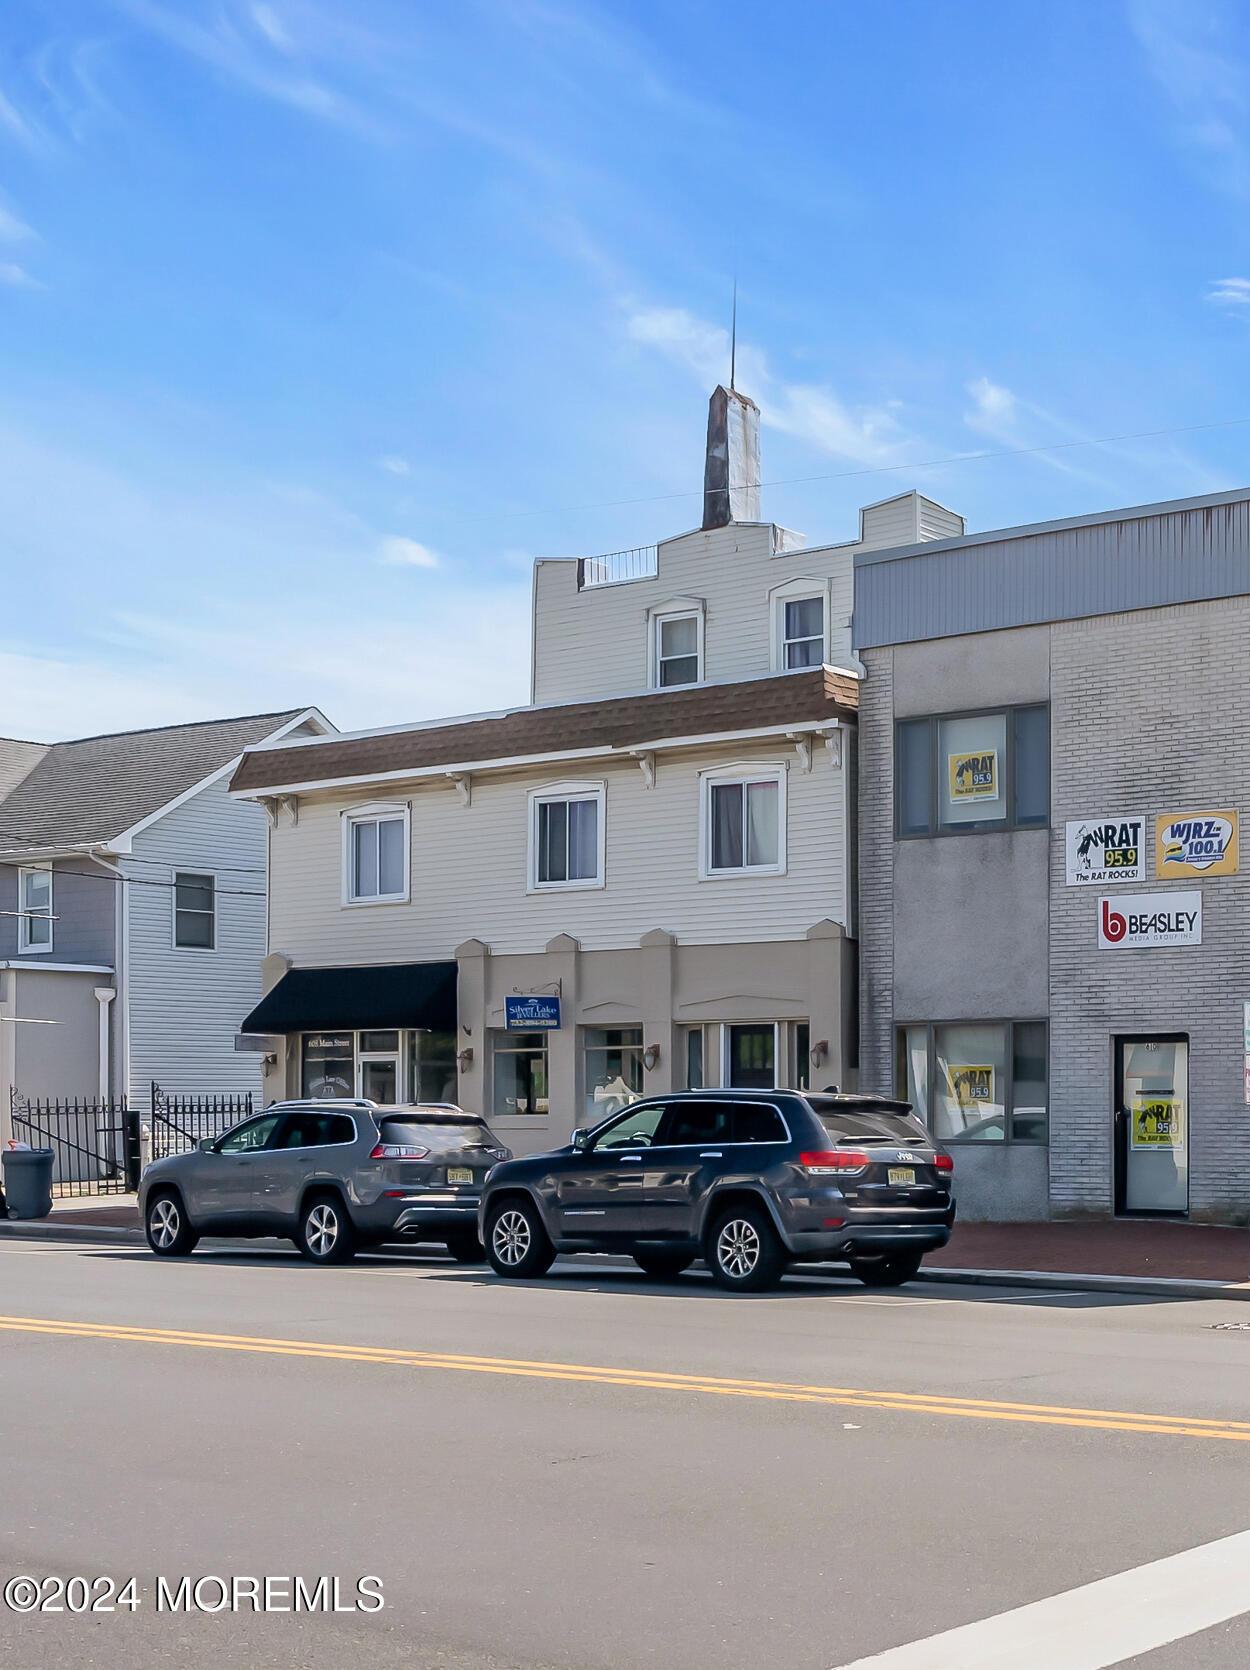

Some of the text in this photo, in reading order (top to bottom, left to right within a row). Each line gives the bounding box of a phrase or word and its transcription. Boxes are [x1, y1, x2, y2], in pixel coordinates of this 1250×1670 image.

[973, 773, 992, 785] 95.9
[1170, 821, 1220, 844] WJRZ
[1188, 840, 1223, 855] 100.1
[1105, 849, 1137, 867] 95.9
[1075, 869, 1138, 881] The RAT ROCKS!
[1129, 911, 1197, 934] BEASLEY
